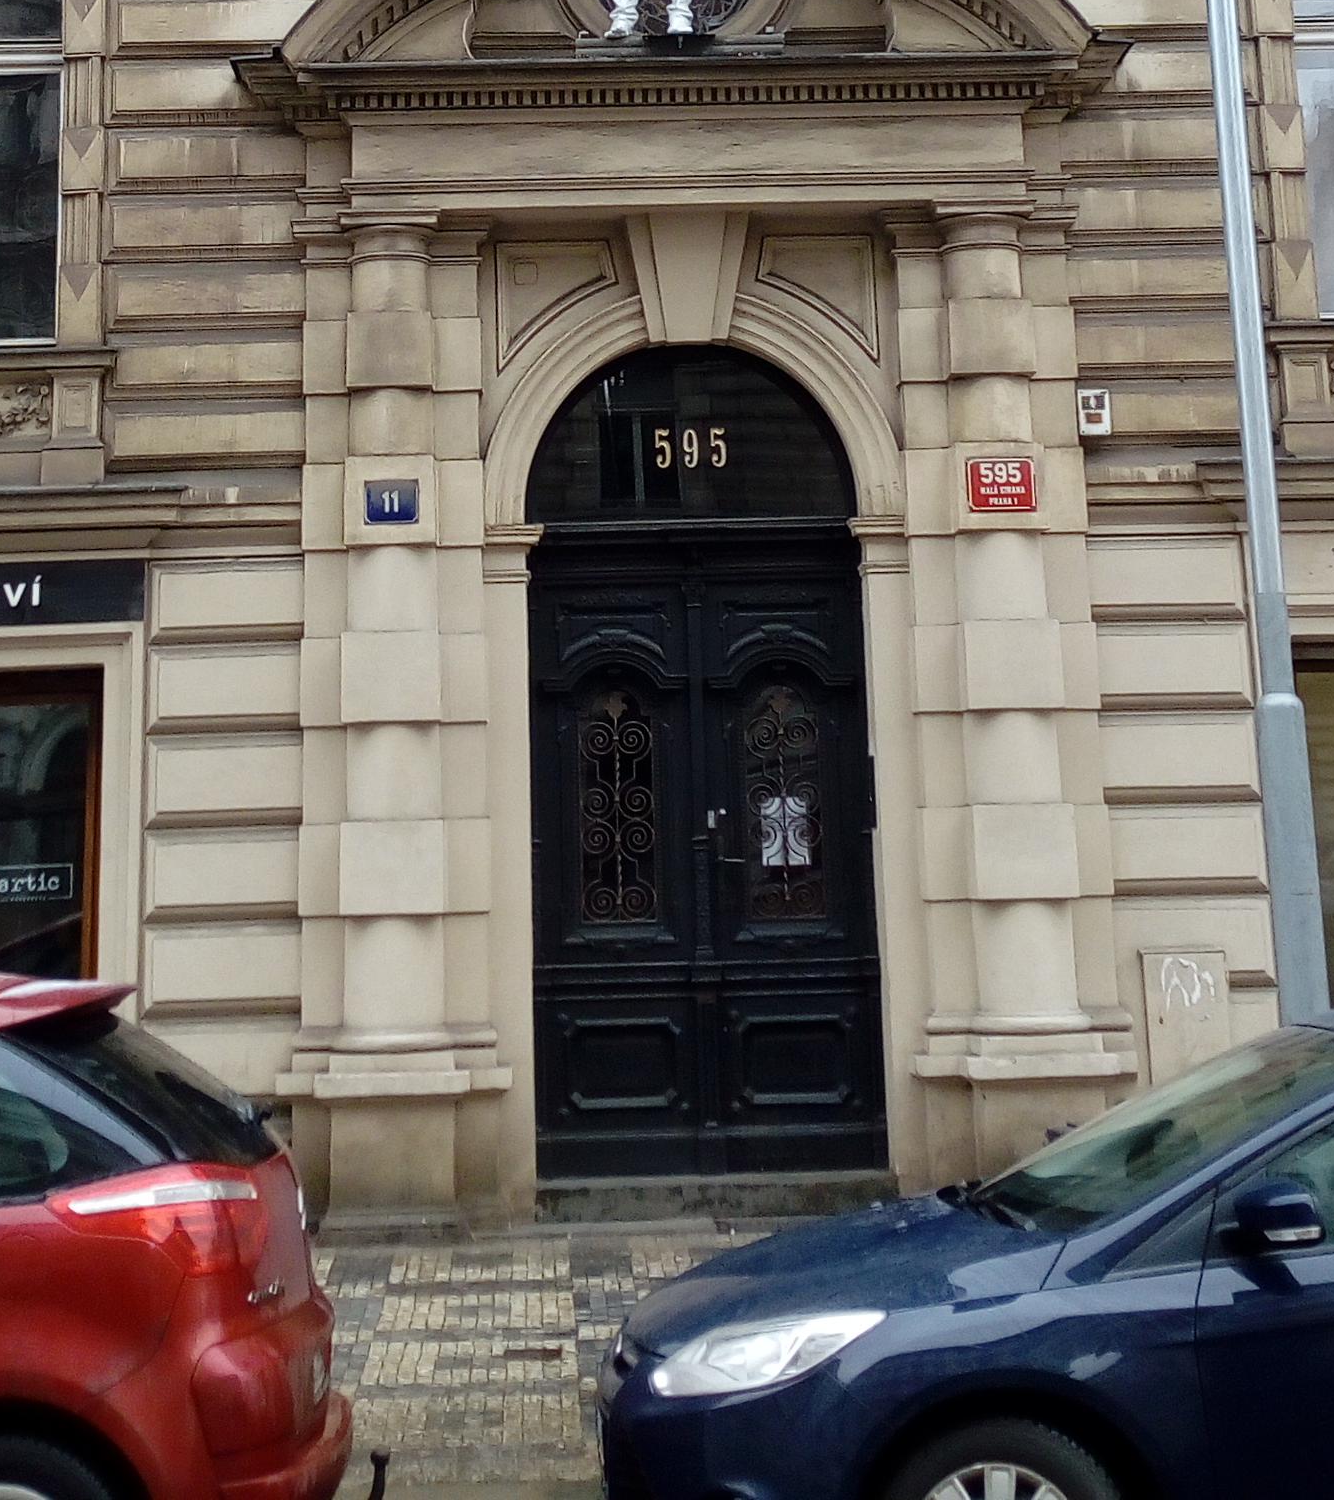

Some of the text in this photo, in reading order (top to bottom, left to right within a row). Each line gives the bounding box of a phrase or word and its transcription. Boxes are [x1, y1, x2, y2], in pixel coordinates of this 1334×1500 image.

[654, 428, 727, 468] 595
[979, 463, 1022, 484] 595
[381, 489, 400, 513] 11
